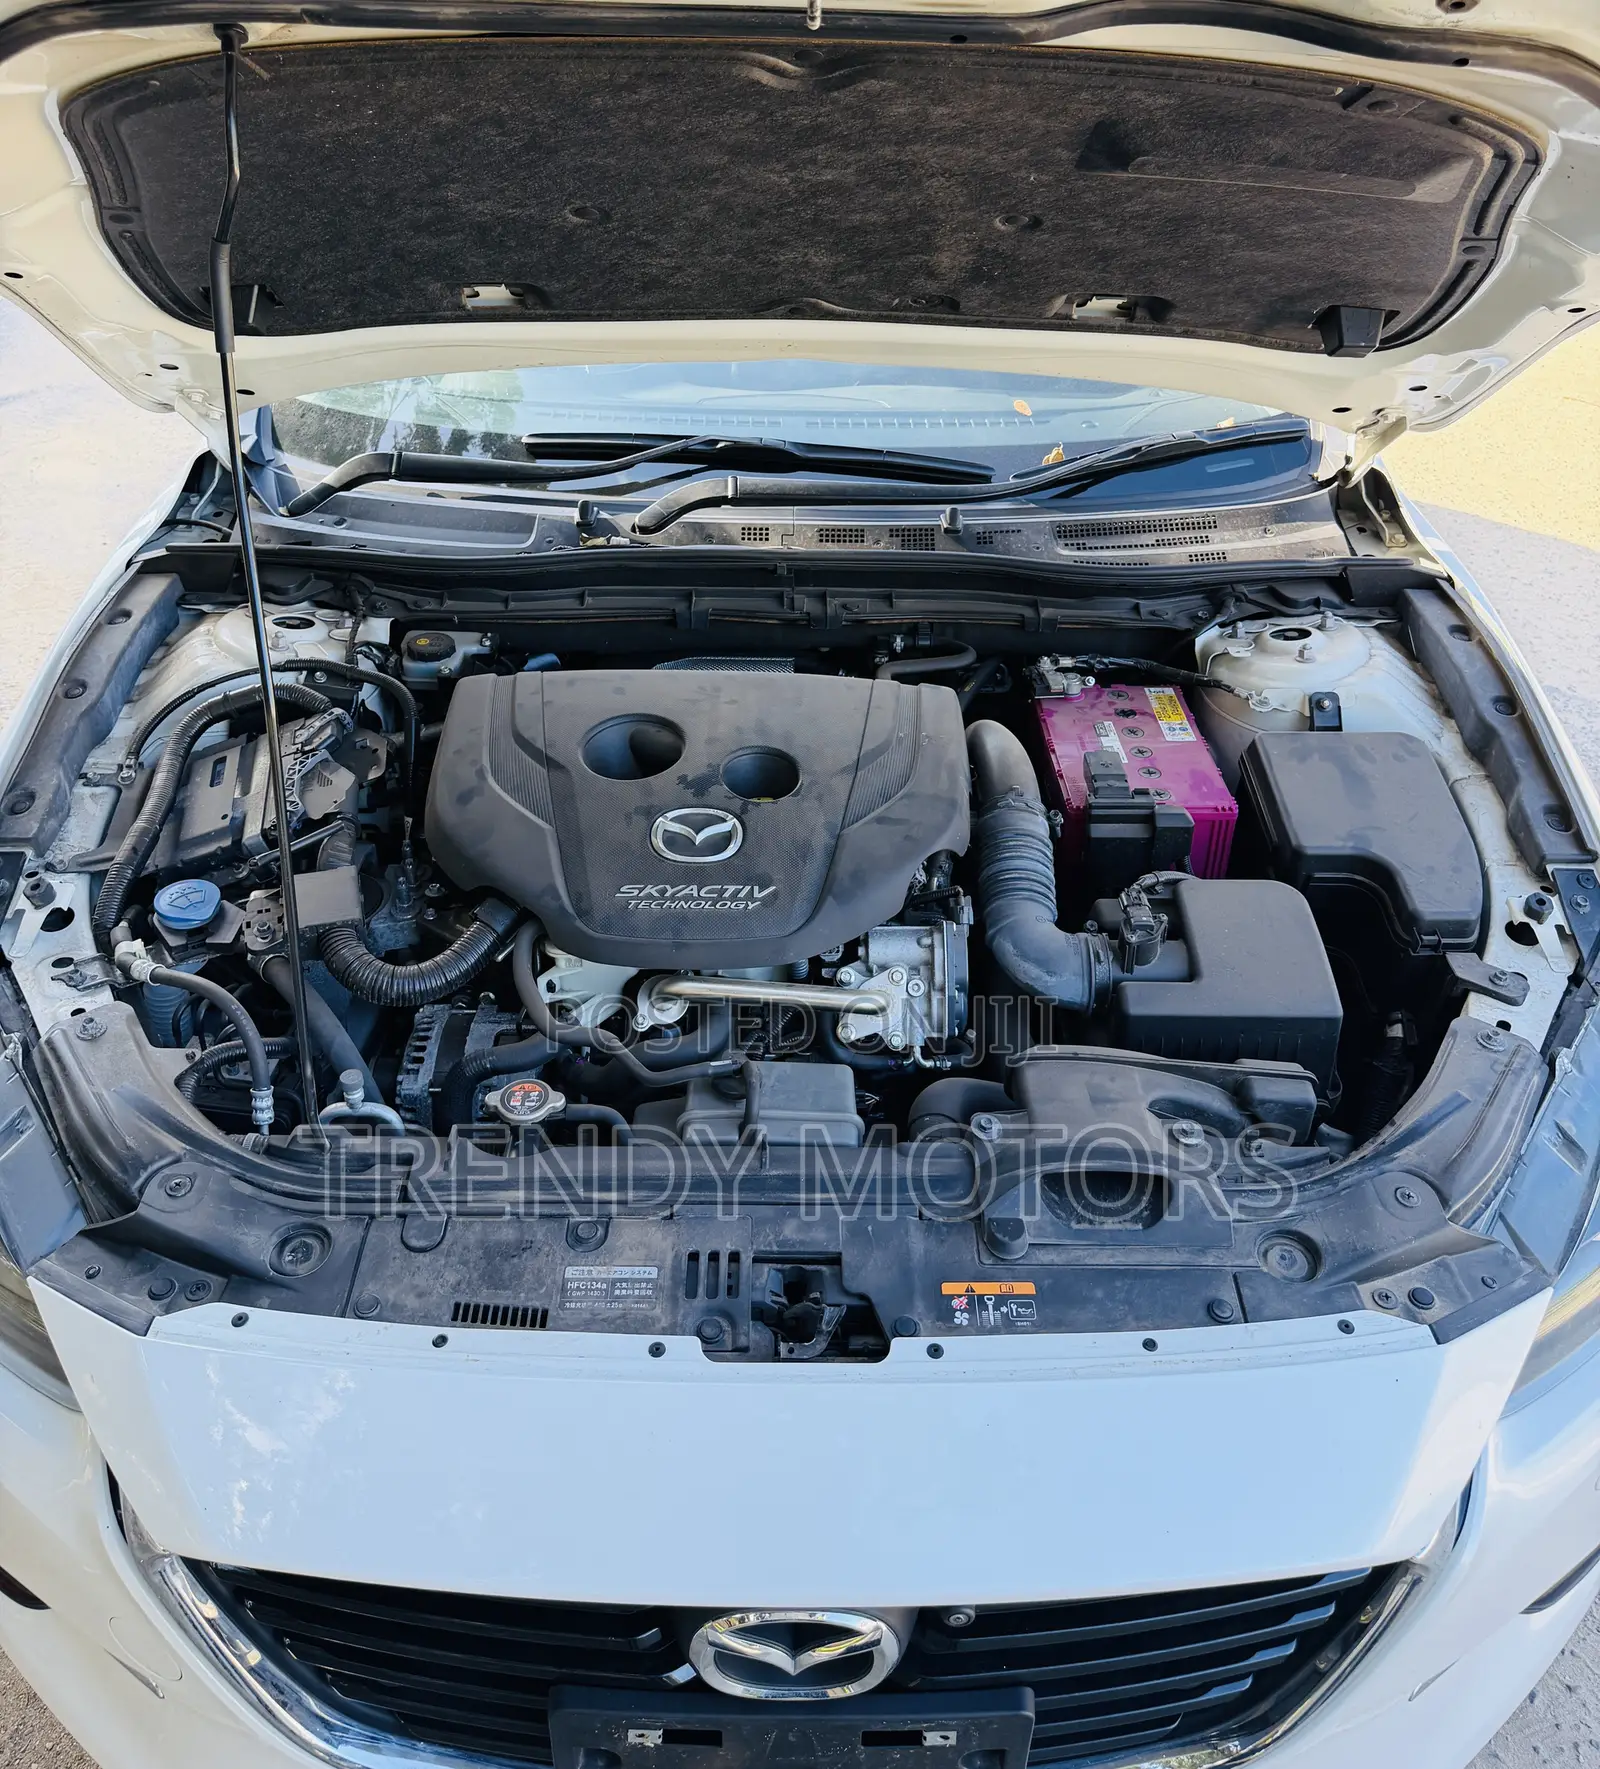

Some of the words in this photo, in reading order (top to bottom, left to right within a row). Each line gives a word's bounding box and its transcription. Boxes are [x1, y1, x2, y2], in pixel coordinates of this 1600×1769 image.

[615, 884, 777, 899] SKYACTIV
[627, 900, 761, 910] TECHNOLOGY
[567, 1281, 607, 1289] HFC134a
